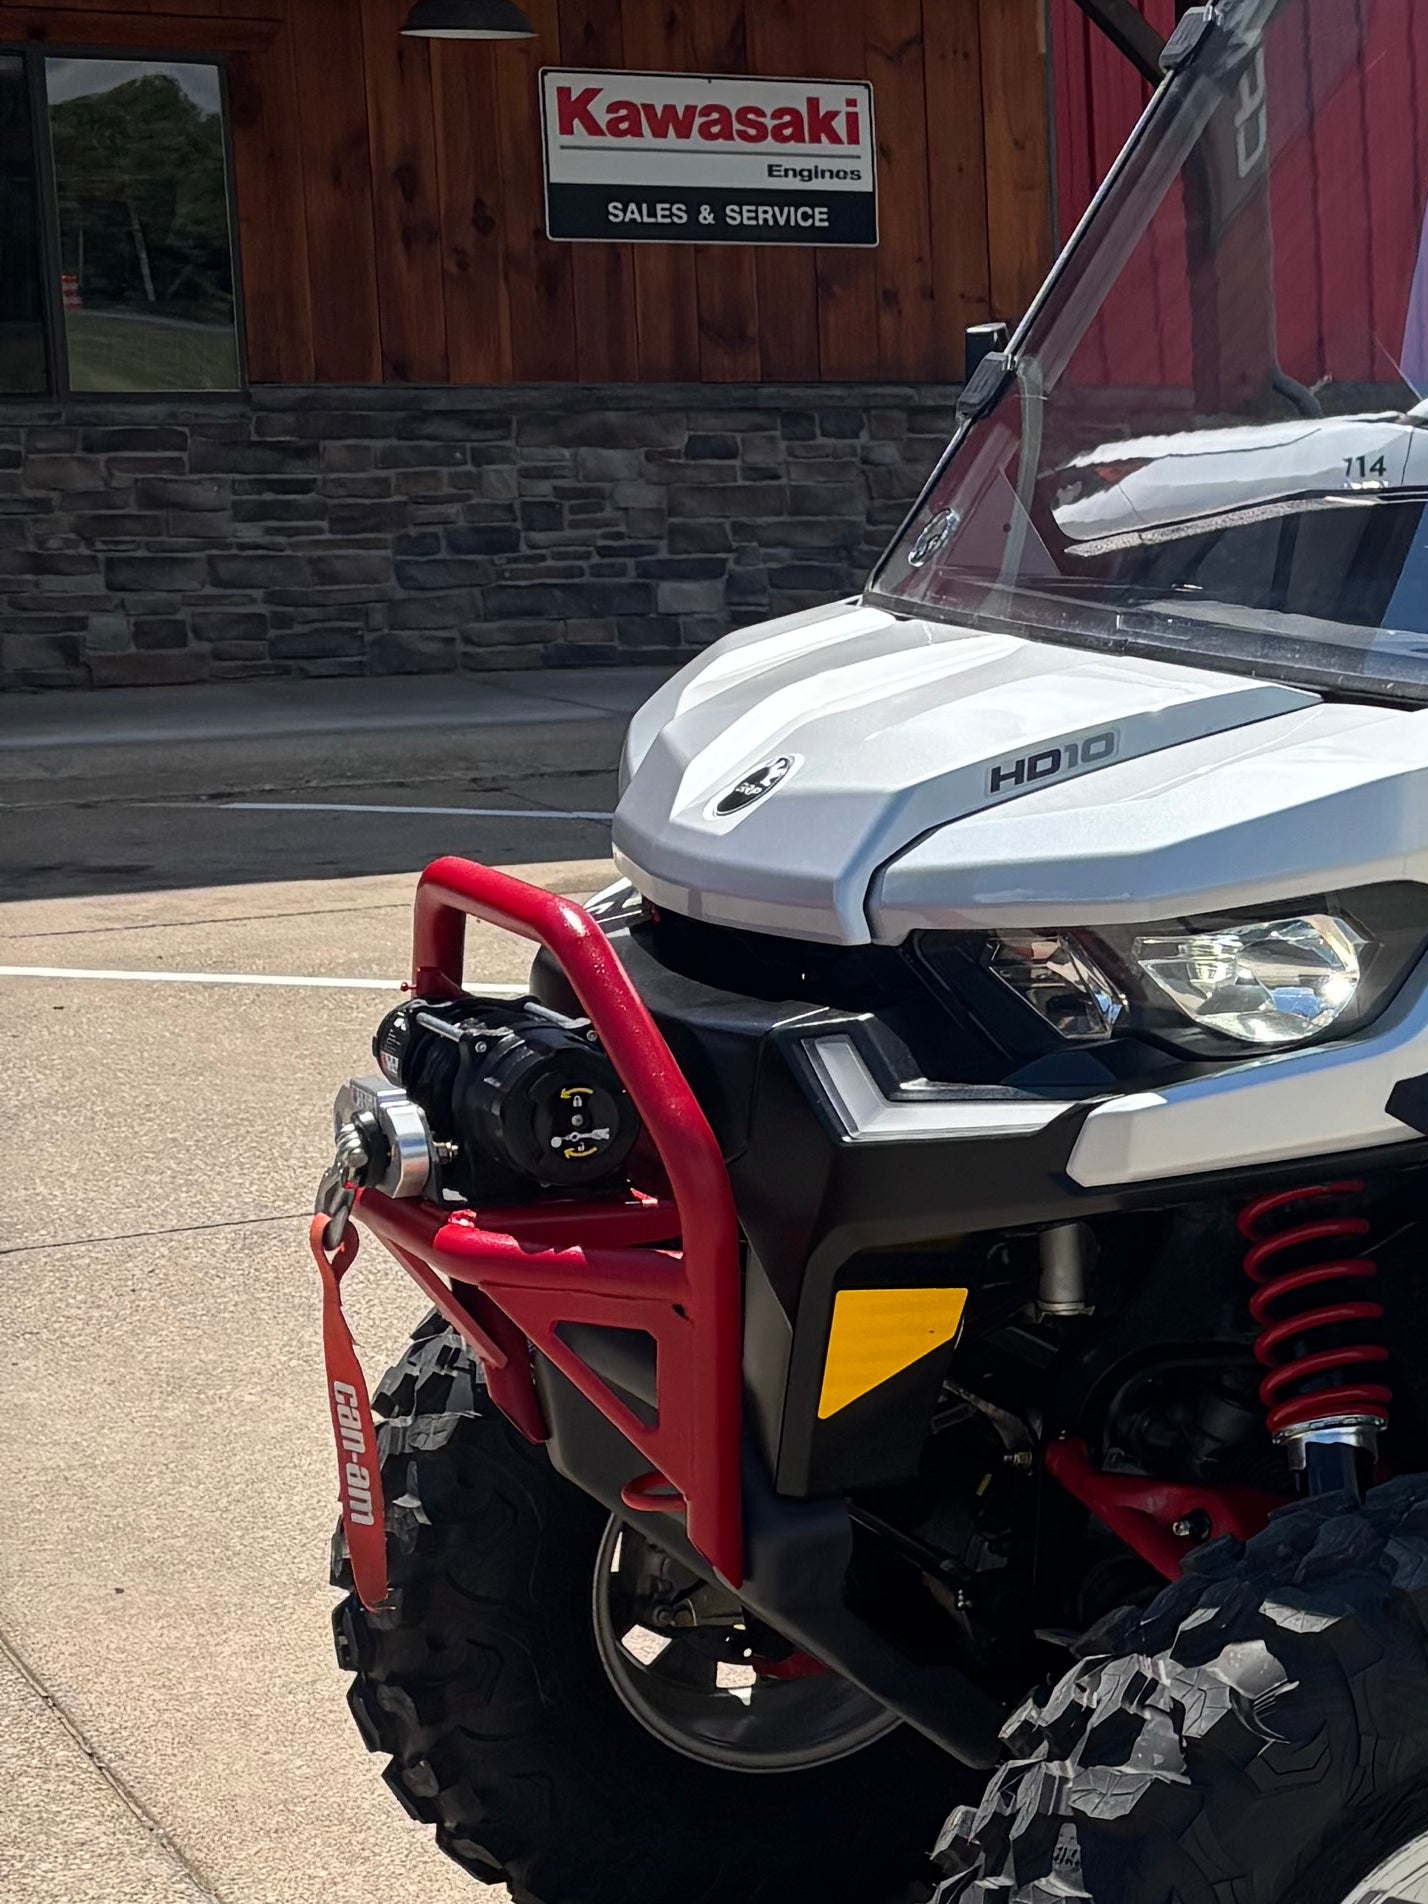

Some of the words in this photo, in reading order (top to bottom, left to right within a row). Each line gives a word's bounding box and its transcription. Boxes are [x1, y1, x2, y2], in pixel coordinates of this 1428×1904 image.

[556, 86, 861, 146] Kawasaki
[767, 164, 862, 182] Engines
[607, 202, 688, 225] SALES
[699, 205, 715, 225] &
[725, 206, 829, 228] SERVICE
[990, 732, 1115, 793] HD10
[334, 1380, 375, 1526] can-am
